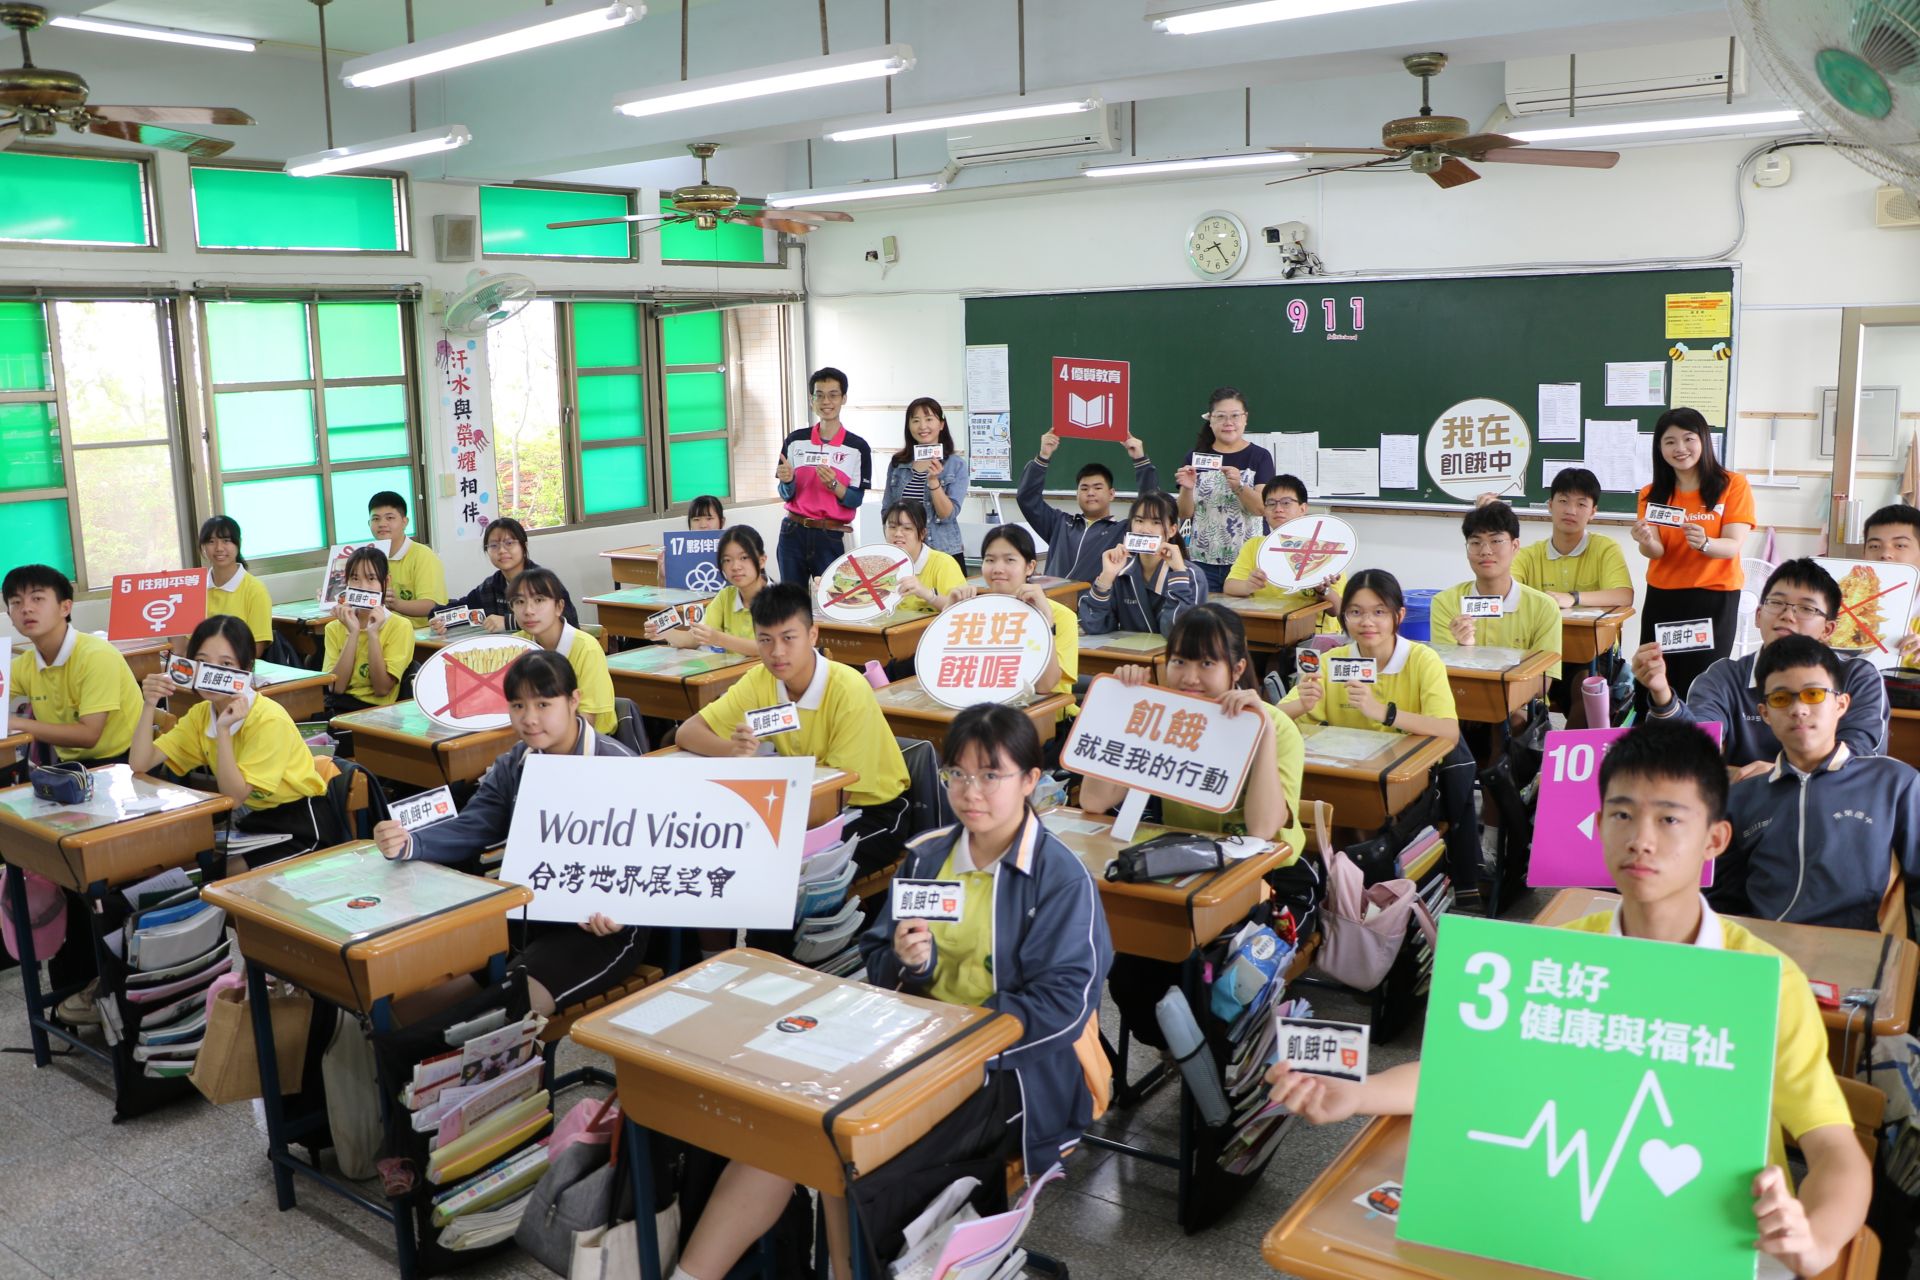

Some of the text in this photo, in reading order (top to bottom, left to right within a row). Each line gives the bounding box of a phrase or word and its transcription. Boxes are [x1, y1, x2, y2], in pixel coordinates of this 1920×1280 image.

[1213, 221, 1219, 229] 12
[1287, 297, 1364, 333] 911
[1060, 364, 1121, 384] 4 優質教育
[451, 350, 480, 523] 汗水與榮耀相伴
[1442, 414, 1511, 449] 我在
[1441, 450, 1511, 475] 飢餓中
[670, 537, 685, 556] 17
[121, 574, 200, 593] 5 性別平等
[1466, 600, 1489, 613] 飢餓中
[947, 612, 1029, 646] 我好
[1662, 628, 1693, 646] 飢餓中
[202, 671, 233, 687] 飢餓中
[937, 655, 1022, 688] 餓喔
[1334, 664, 1360, 677] 飢餓中
[753, 712, 780, 731] 飢餓中
[1124, 699, 1208, 752] 飢餓
[1074, 732, 1229, 796] 就是我的行動
[1548, 744, 1595, 782] 10
[399, 800, 432, 827] 飢餓中
[540, 807, 744, 849] World Vision
[901, 890, 940, 910] 飢餓中
[1459, 951, 1610, 1031] 3 良好
[1287, 1035, 1337, 1062] 飢餓中
[1519, 1000, 1735, 1070] 健康與福祉
